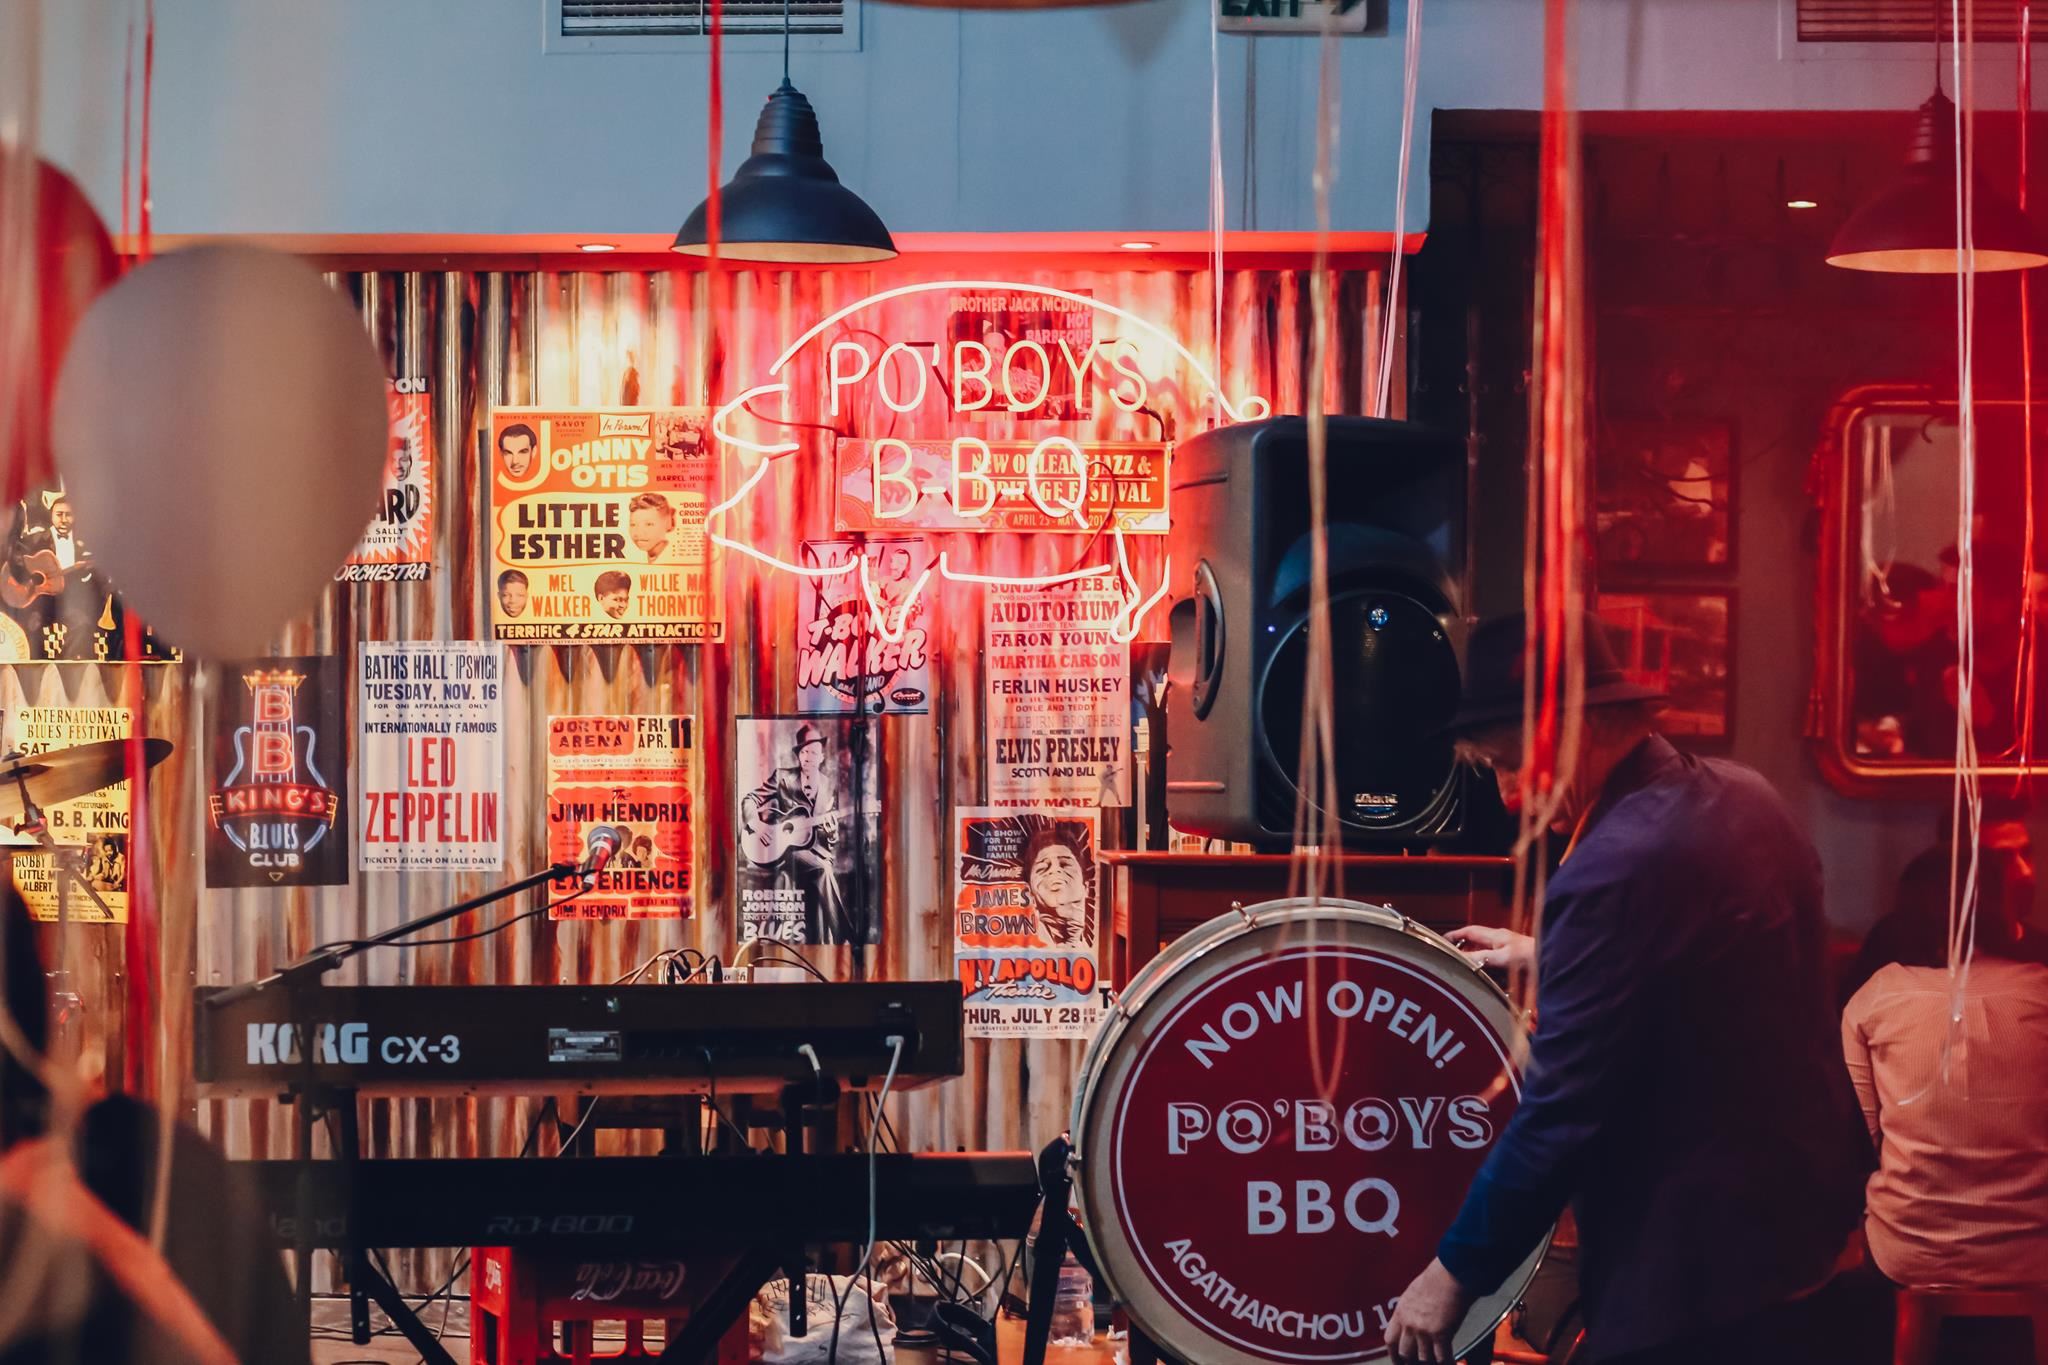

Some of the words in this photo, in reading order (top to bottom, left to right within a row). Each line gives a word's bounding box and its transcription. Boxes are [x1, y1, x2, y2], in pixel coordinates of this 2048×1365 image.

[950, 296, 1007, 312] BROTHER
[1008, 297, 1040, 312] JACK
[1066, 313, 1089, 328] HOT
[831, 338, 1147, 416] PO'BOYS
[555, 420, 586, 428] SAVOY
[603, 420, 613, 430] In
[497, 421, 652, 492] JOHNNY
[1094, 454, 1134, 477] JAZZ
[1137, 455, 1151, 475] &
[571, 465, 649, 488] OTIS
[518, 503, 620, 529] LITTLE
[511, 533, 626, 560] ESTHER
[334, 562, 425, 581] ORCHESTRA
[549, 574, 575, 593] MEL
[640, 573, 680, 593] WILLIE
[531, 595, 591, 617] WALKER
[991, 600, 1120, 623] AUDITORIUM
[497, 624, 562, 638] TERRIFIC
[581, 624, 622, 638] STAR
[991, 633, 1053, 647] FARON
[365, 655, 408, 680] BATHS
[413, 655, 449, 680] HALL
[455, 654, 498, 680] IPSWICH
[799, 629, 927, 690] WALKER
[991, 655, 1057, 669] MARTHA
[1060, 654, 1121, 668] CARSON
[365, 683, 437, 702] TUESDAY,
[443, 683, 476, 700] NOV.
[481, 683, 498, 700] 16
[993, 679, 1050, 694] FERLIN
[1055, 678, 1122, 693] HUSKEY
[256, 689, 291, 723] B
[33, 708, 119, 724] INTERNATIONAL
[637, 717, 667, 733] FRI.
[27, 724, 61, 738] BLUES
[68, 725, 121, 740] FESTIVAL
[365, 722, 452, 734] INTERNATIONALLY
[455, 722, 498, 734] FAMOUS
[552, 719, 630, 734] DORTON
[669, 717, 693, 749] 11
[558, 734, 623, 748] ARENA
[637, 733, 668, 749] APR.
[996, 738, 1041, 764] ELVIS
[1045, 737, 1120, 763] PRESLEY
[255, 731, 295, 774] B
[407, 737, 456, 787] LED
[1011, 767, 1050, 778] SCOTTY
[1052, 766, 1074, 777] AND
[1076, 766, 1096, 777] BILL
[226, 788, 326, 813] KING'S
[53, 810, 69, 828] B.
[73, 810, 86, 828] B.
[92, 811, 129, 829] KING
[365, 792, 498, 843] ZEPPELIN
[551, 803, 595, 823] JIMI
[602, 803, 690, 823] HENDRIX
[250, 822, 299, 850] BLUES
[15, 855, 45, 869] BOBBY
[250, 852, 300, 867] CLUB
[19, 869, 45, 880] LITTLE
[23, 881, 53, 892] ALBERT
[742, 888, 806, 901] ROBERT
[742, 901, 806, 912] JOHNSON
[971, 888, 1031, 909] JAMES
[581, 903, 627, 918] HENDRIX
[743, 920, 807, 942] BLUES
[960, 912, 1038, 935] BROWN
[998, 956, 1096, 997] APOLLO
[1011, 1007, 1053, 1024] JULY
[1058, 1007, 1080, 1023] 28
[1184, 981, 1304, 1069] NOW
[1326, 980, 1467, 1070] OPEN!
[381, 1035, 461, 1064] CX-3
[1167, 1095, 1494, 1155] PO'BOYS
[1247, 1177, 1400, 1238] BBQ
[487, 1215, 635, 1234] RD-800
[1163, 1238, 1365, 1340] AGATHARCHOU
